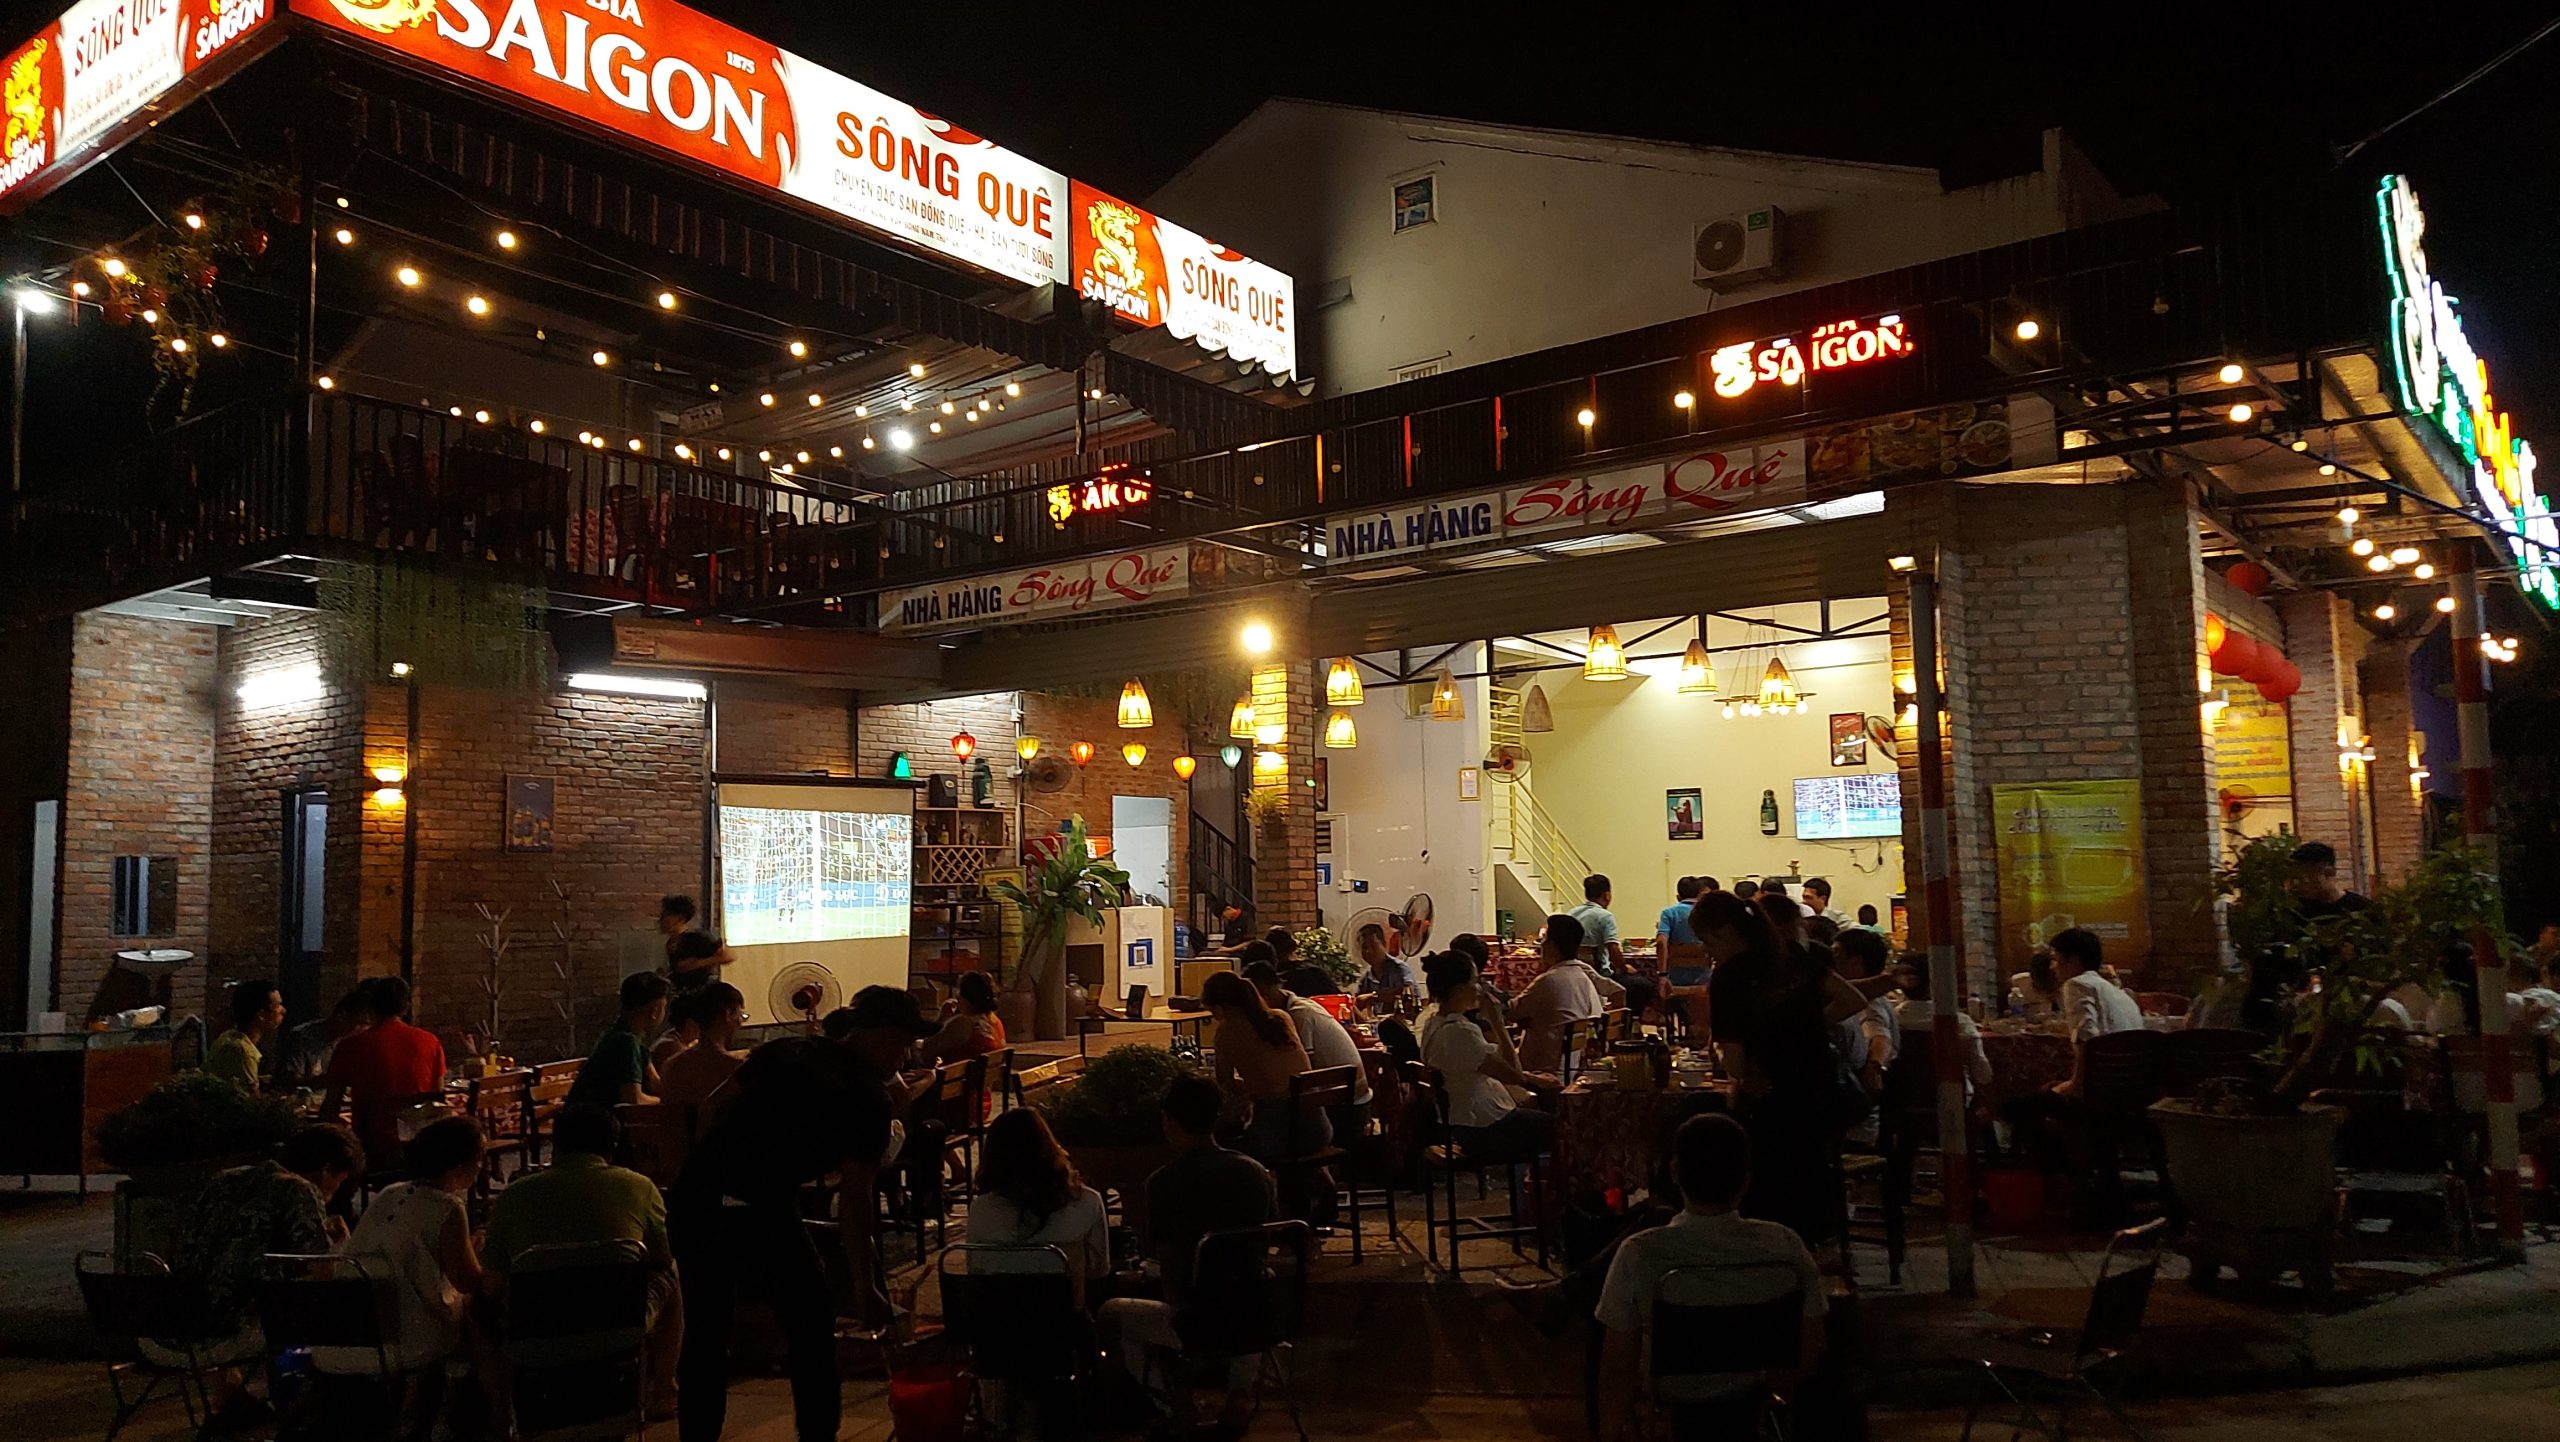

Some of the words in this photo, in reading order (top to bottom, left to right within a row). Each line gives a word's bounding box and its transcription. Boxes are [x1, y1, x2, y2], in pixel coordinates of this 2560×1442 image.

[726, 51, 756, 74] 1875
[835, 111, 960, 201] SÔNG
[977, 171, 1054, 241] QUÊ
[1081, 276, 1150, 321] SAIGON
[1182, 256, 1240, 314] SÔNG
[1248, 285, 1285, 333] QUÊ
[1757, 322, 1904, 383] SAIGON
[1335, 511, 1397, 559] NHÀ
[1405, 499, 1492, 548] HÀNG
[1503, 478, 1649, 528] Sông
[1663, 449, 1788, 511] Quê
[902, 589, 942, 626] NHÀ
[947, 584, 1003, 620] HÀNG
[1008, 570, 1097, 611] Sông
[1105, 554, 1180, 601] Quê
